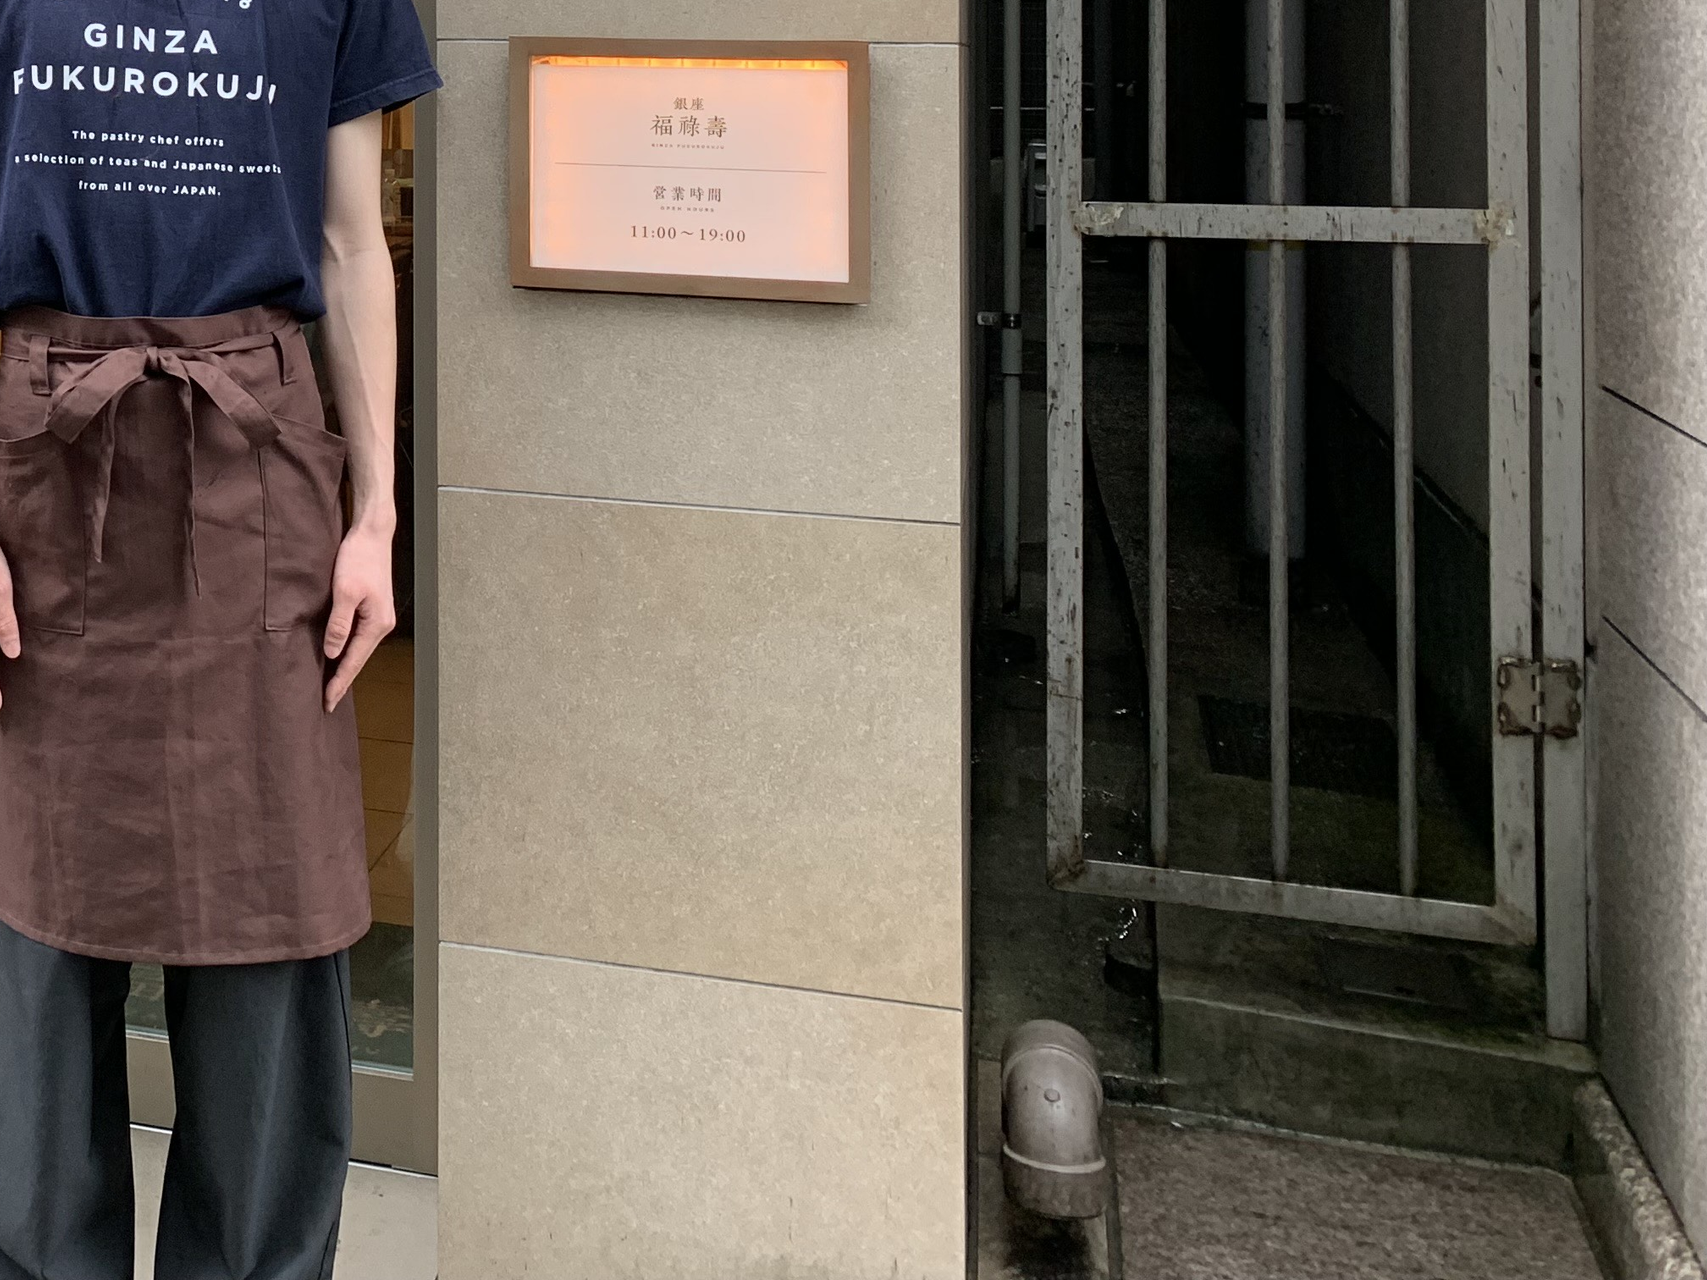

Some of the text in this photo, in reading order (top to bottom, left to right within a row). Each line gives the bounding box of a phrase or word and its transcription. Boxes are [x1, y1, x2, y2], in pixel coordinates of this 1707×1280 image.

[83, 22, 219, 55] GINZA
[673, 96, 705, 111] 銀座
[72, 129, 225, 147] The pastry chef offers
[23, 152, 85, 165] selection
[89, 154, 105, 166] of
[108, 156, 139, 167] teas
[143, 158, 168, 169] and
[172, 159, 234, 174] Japanese
[78, 179, 222, 197] from all over JAPAN.
[652, 185, 722, 203] 営業時間
